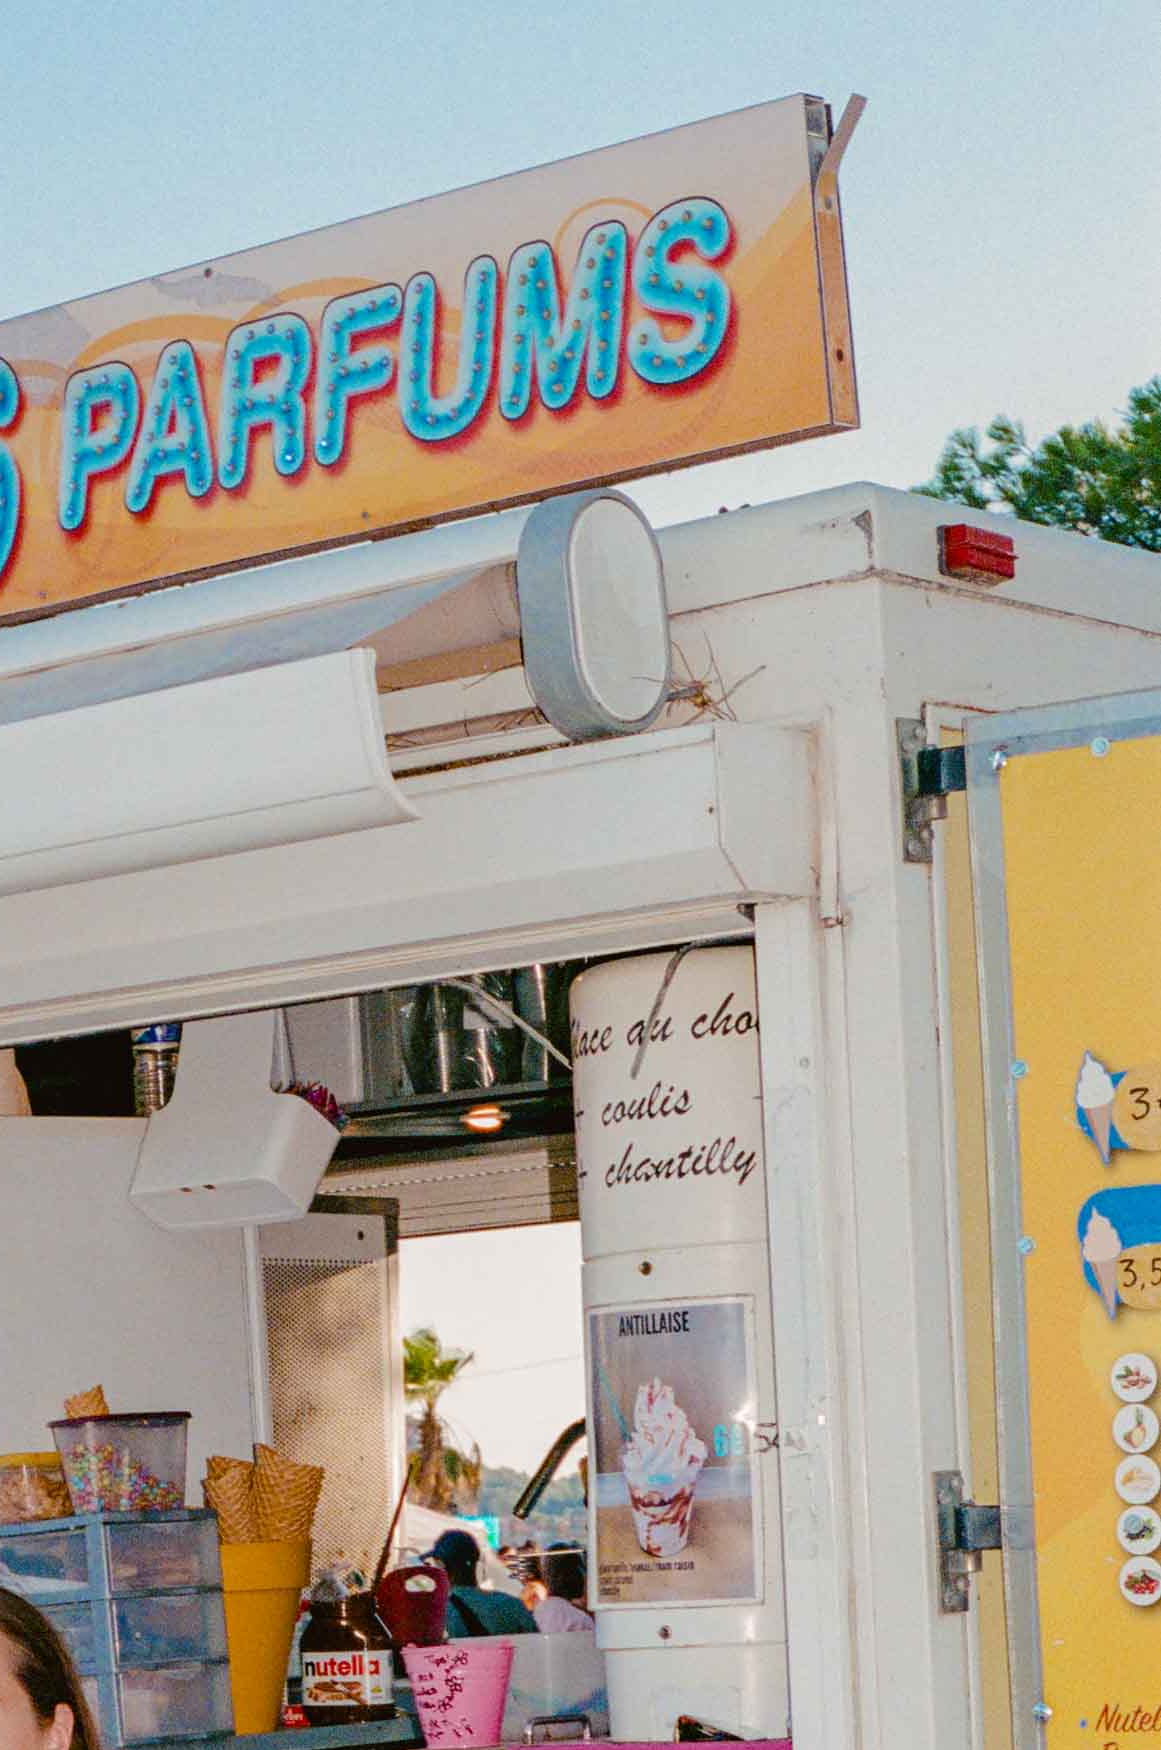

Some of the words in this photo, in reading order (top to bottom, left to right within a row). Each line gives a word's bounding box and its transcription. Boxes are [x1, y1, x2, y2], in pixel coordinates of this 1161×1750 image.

[59, 196, 732, 533] PARFUMS
[601, 1080, 694, 1127] coulis
[1129, 1087, 1161, 1121] 3
[605, 1136, 757, 1189] chantilly
[618, 1310, 691, 1338] ANTILLAISE
